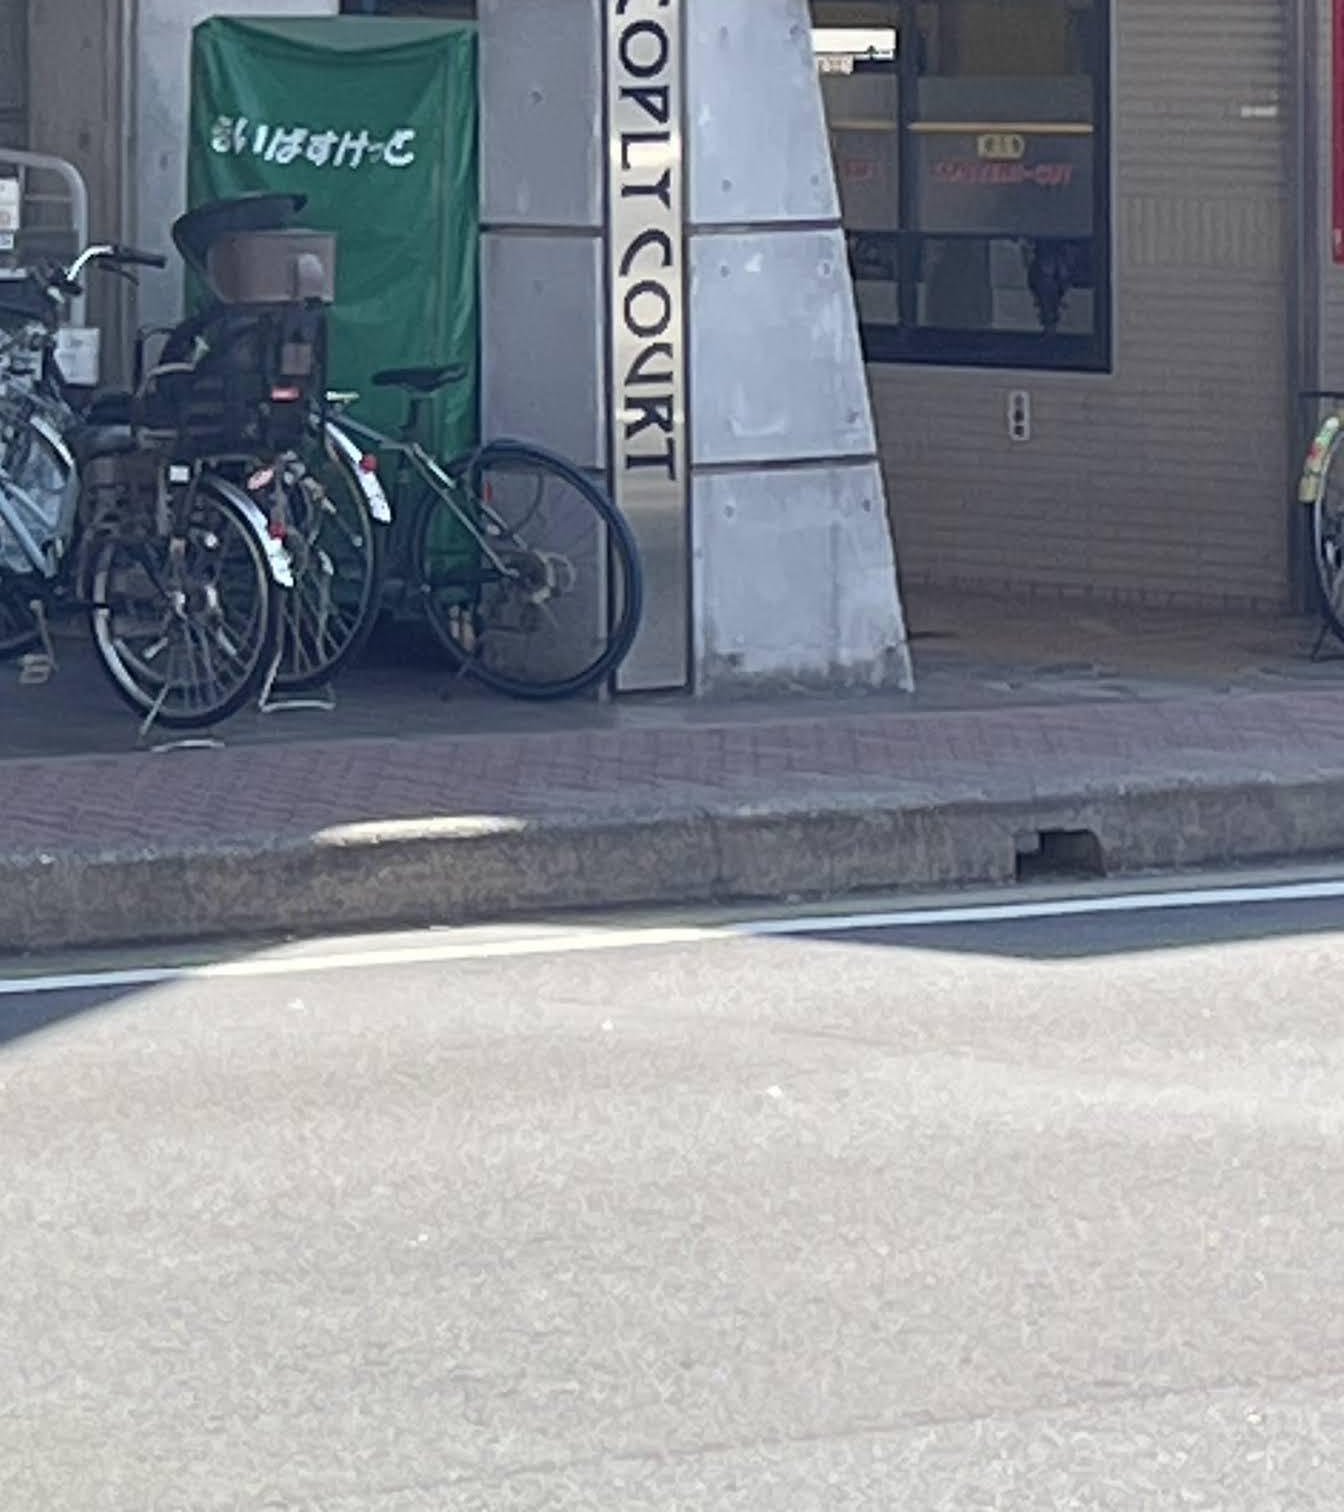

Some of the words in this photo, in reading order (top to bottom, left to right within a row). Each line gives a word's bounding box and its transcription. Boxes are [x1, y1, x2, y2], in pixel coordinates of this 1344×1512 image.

[212, 114, 416, 169] まいばすけっと
[619, 228, 678, 481] COURT
